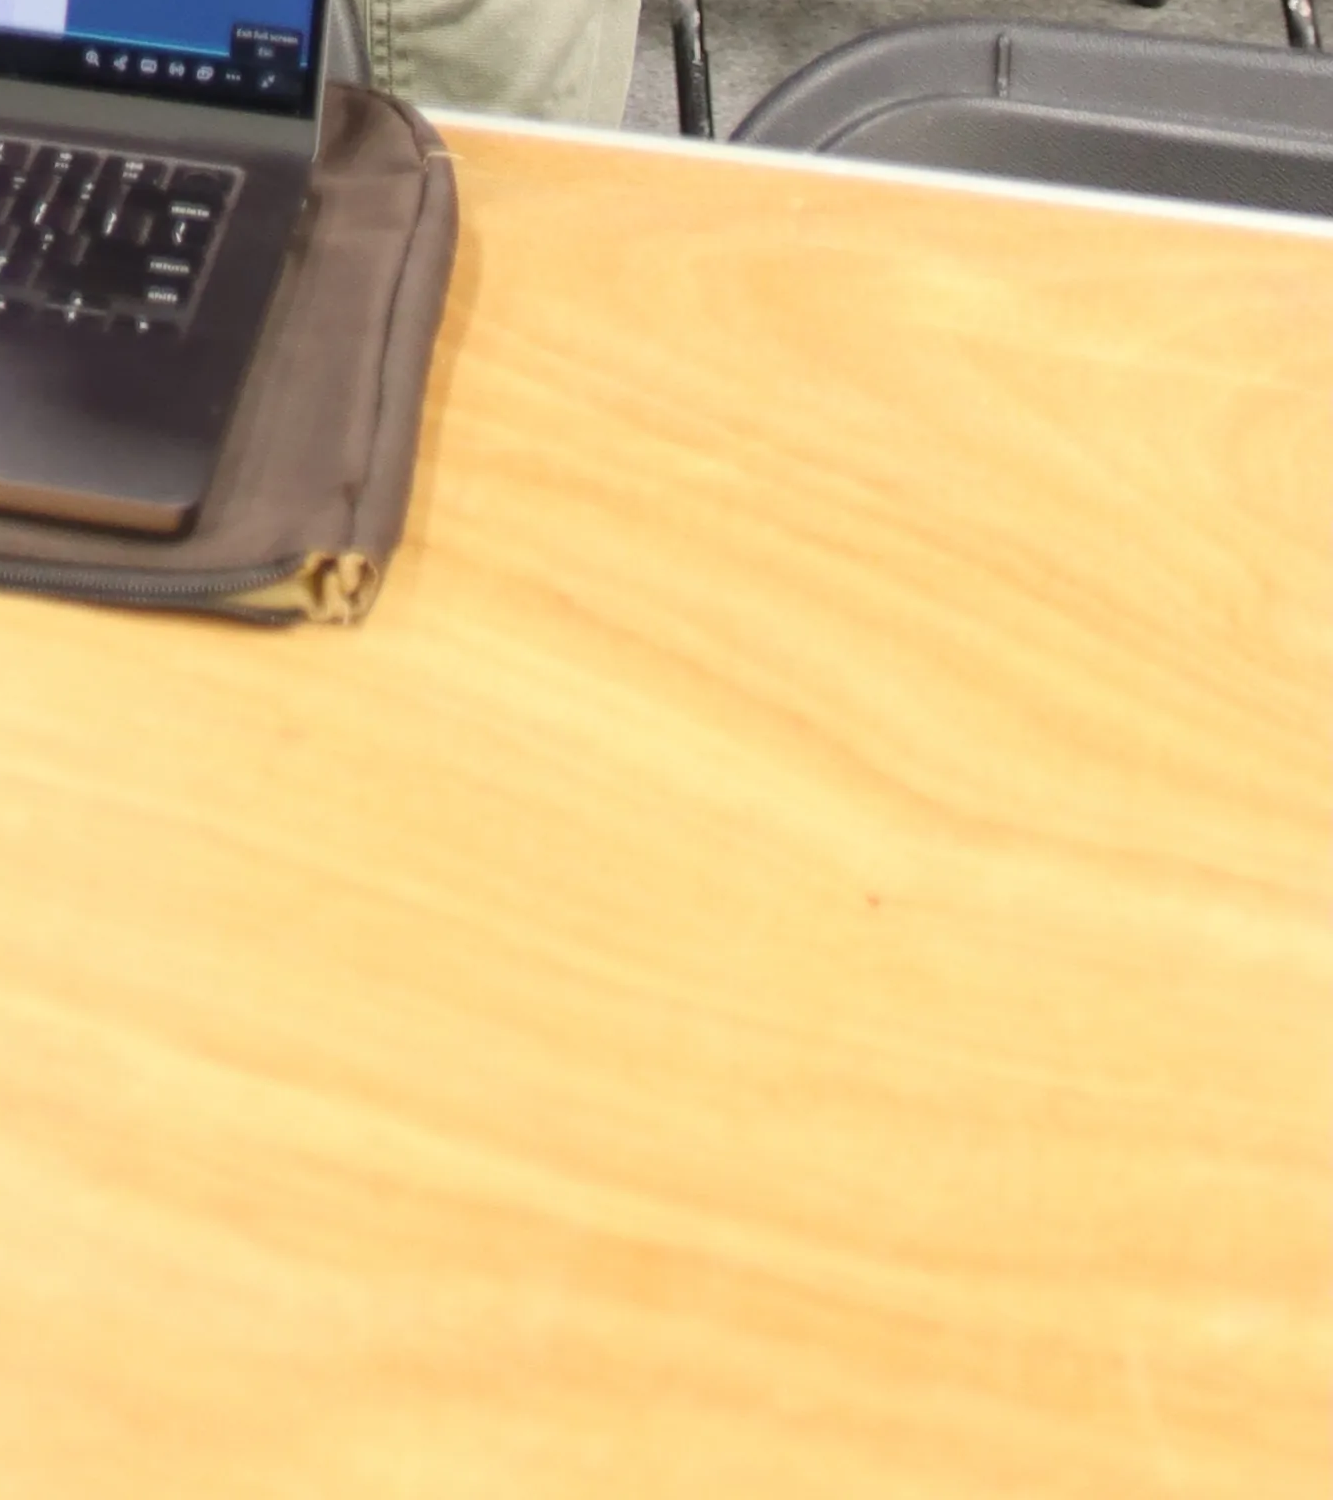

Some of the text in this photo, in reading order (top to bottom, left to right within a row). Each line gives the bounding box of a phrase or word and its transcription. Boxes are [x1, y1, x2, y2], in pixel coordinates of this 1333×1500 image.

[235, 27, 299, 45] Exit full screen
